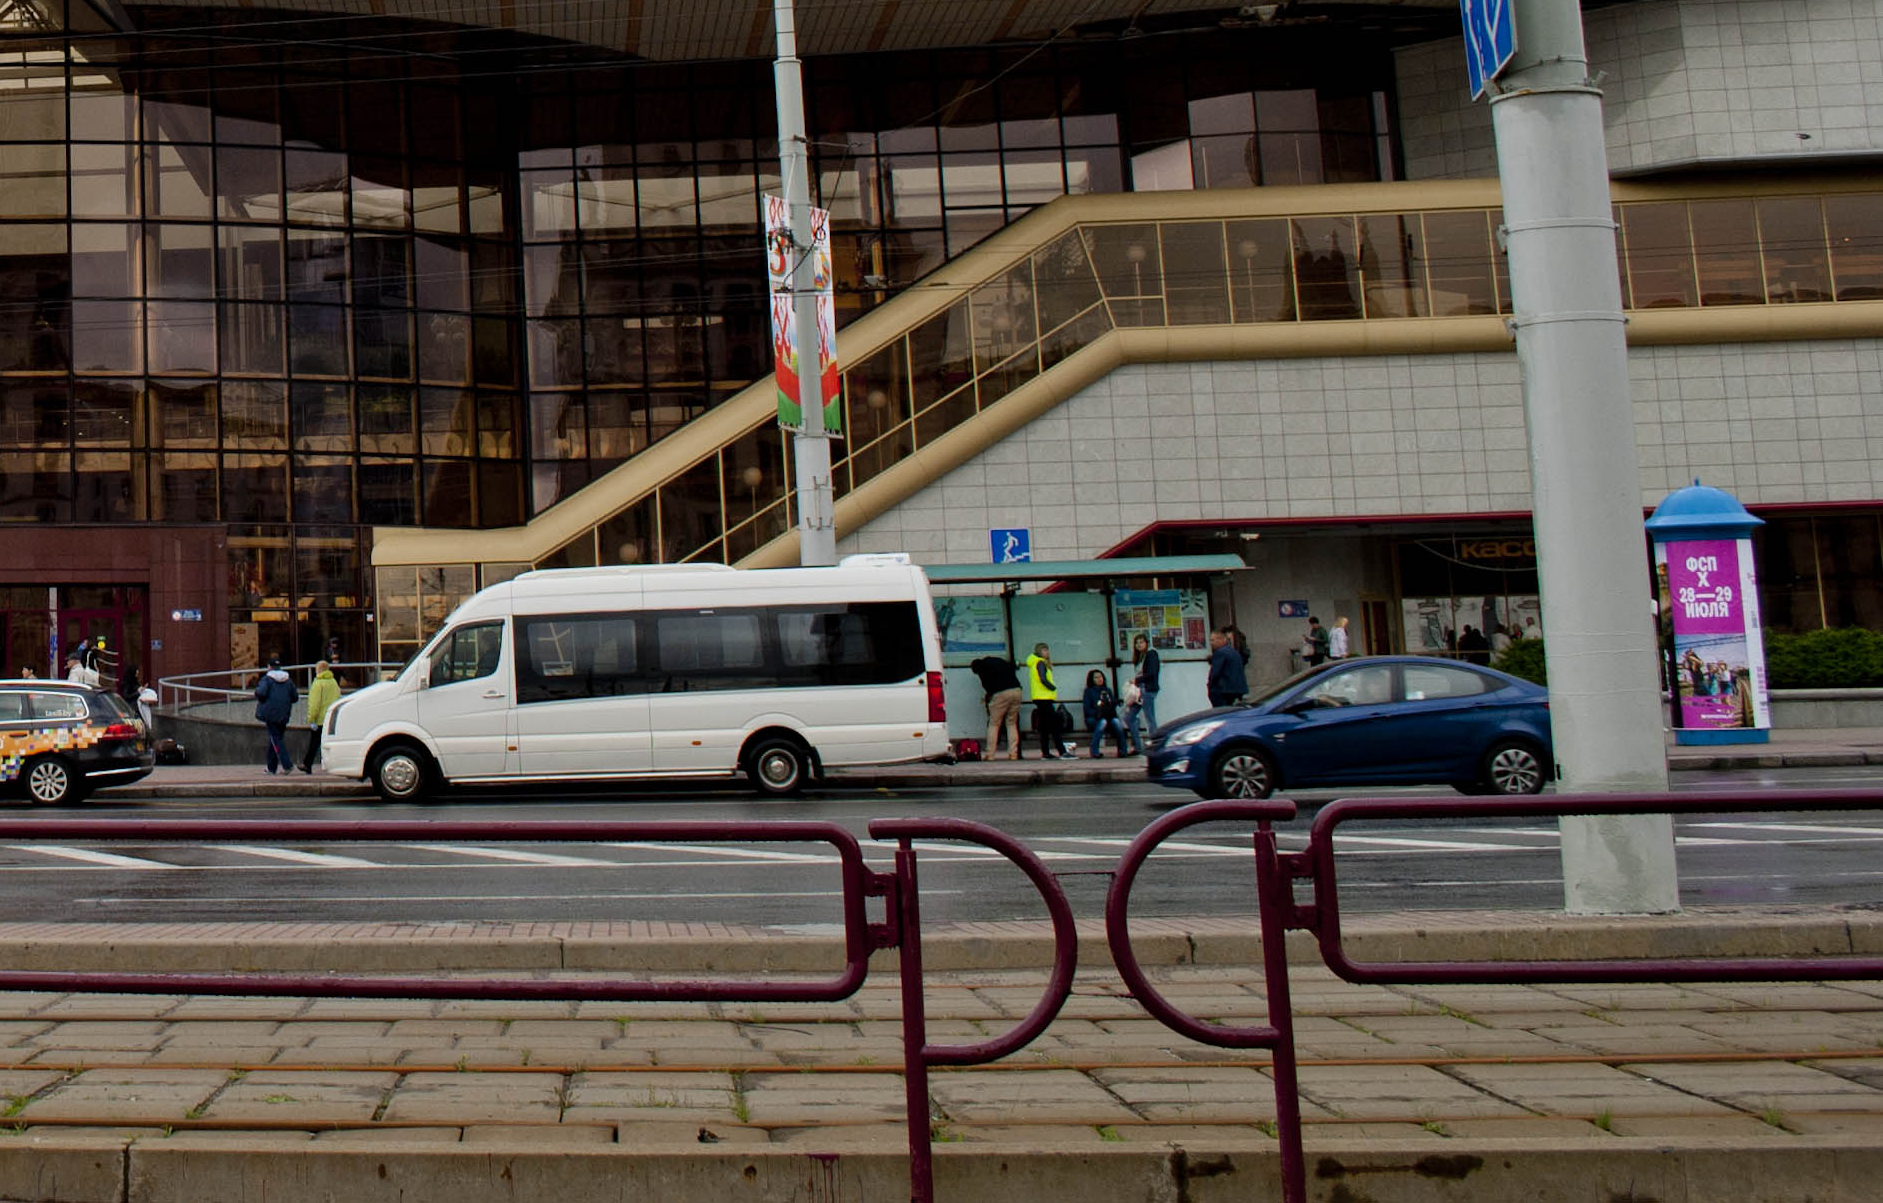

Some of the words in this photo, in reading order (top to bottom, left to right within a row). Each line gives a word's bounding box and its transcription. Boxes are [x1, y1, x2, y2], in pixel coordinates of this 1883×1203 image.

[1461, 541, 1536, 559] касс
[1686, 556, 1718, 572] ФСП
[1685, 601, 1730, 618] ИЮЛЯ
